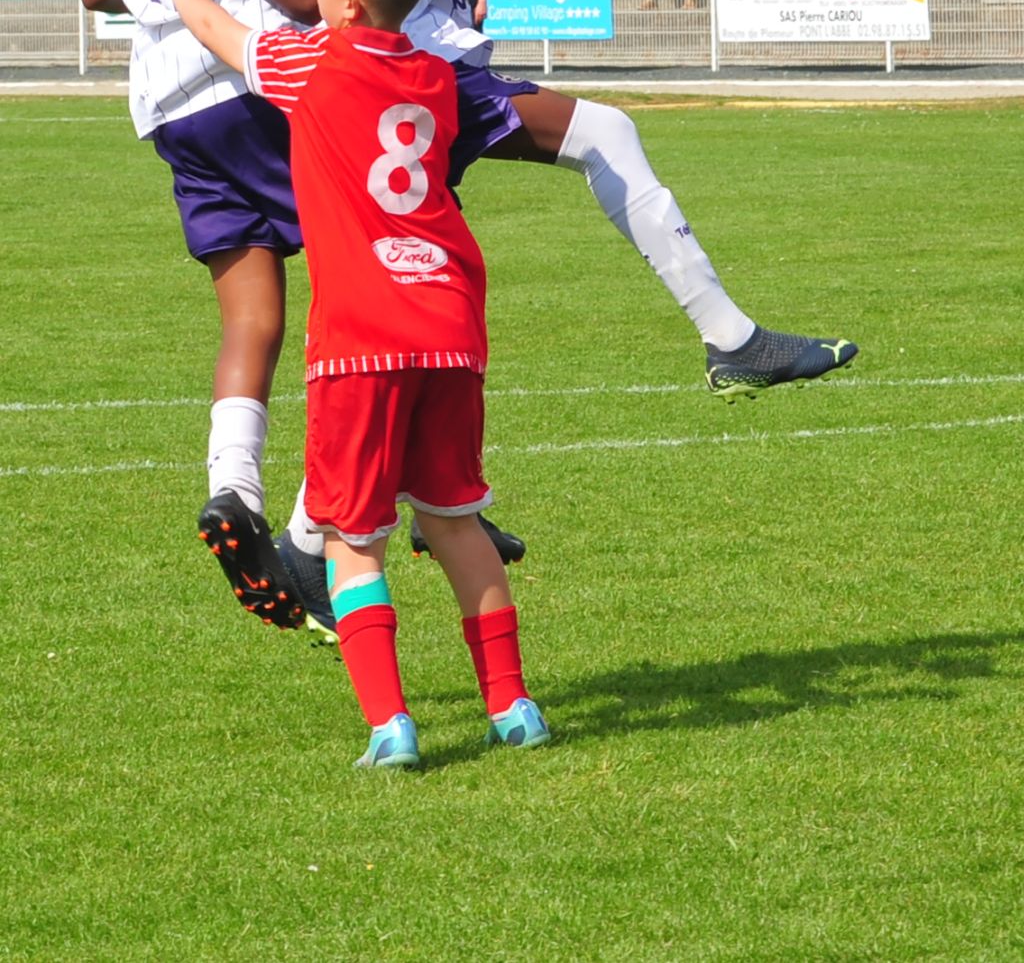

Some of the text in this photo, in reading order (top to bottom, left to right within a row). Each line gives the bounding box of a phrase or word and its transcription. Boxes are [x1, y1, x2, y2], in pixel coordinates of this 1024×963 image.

[488, 4, 565, 23] Camping Village
[779, 10, 863, 23] SAS Pierre CARIOU
[799, 24, 822, 38] PONT
[367, 102, 437, 216] 8
